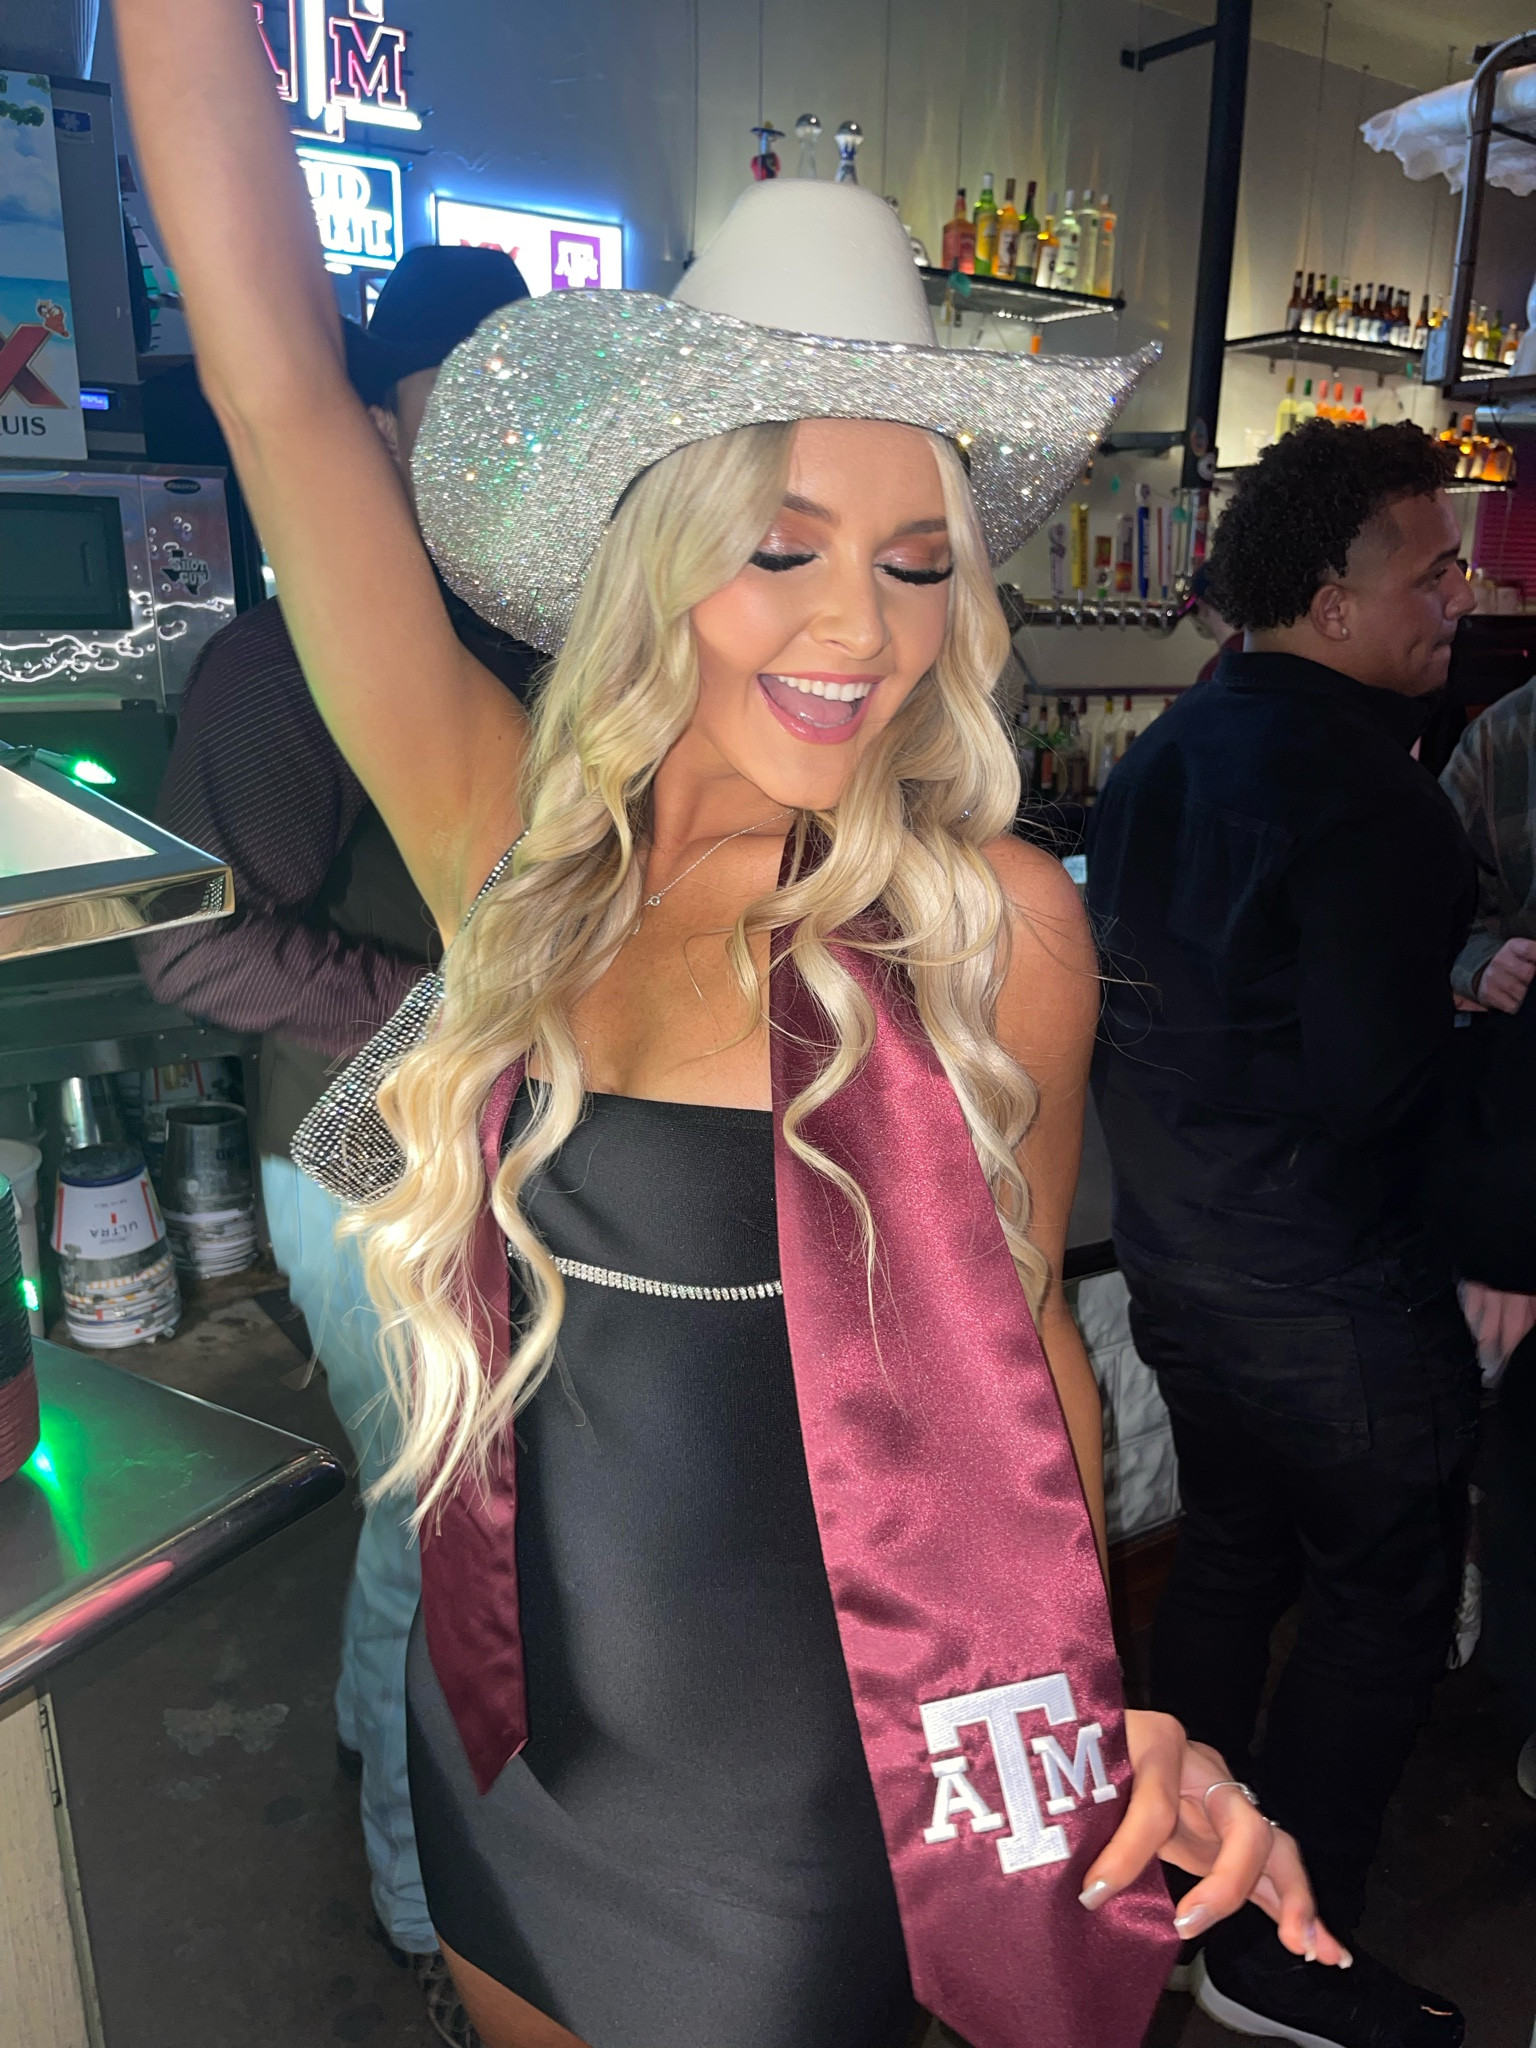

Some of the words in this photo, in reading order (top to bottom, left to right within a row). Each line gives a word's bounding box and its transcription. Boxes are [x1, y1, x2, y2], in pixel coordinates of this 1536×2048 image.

[299, 160, 371, 208] UD
[0, 415, 47, 436] UIS
[89, 1221, 138, 1238] ULTRA
